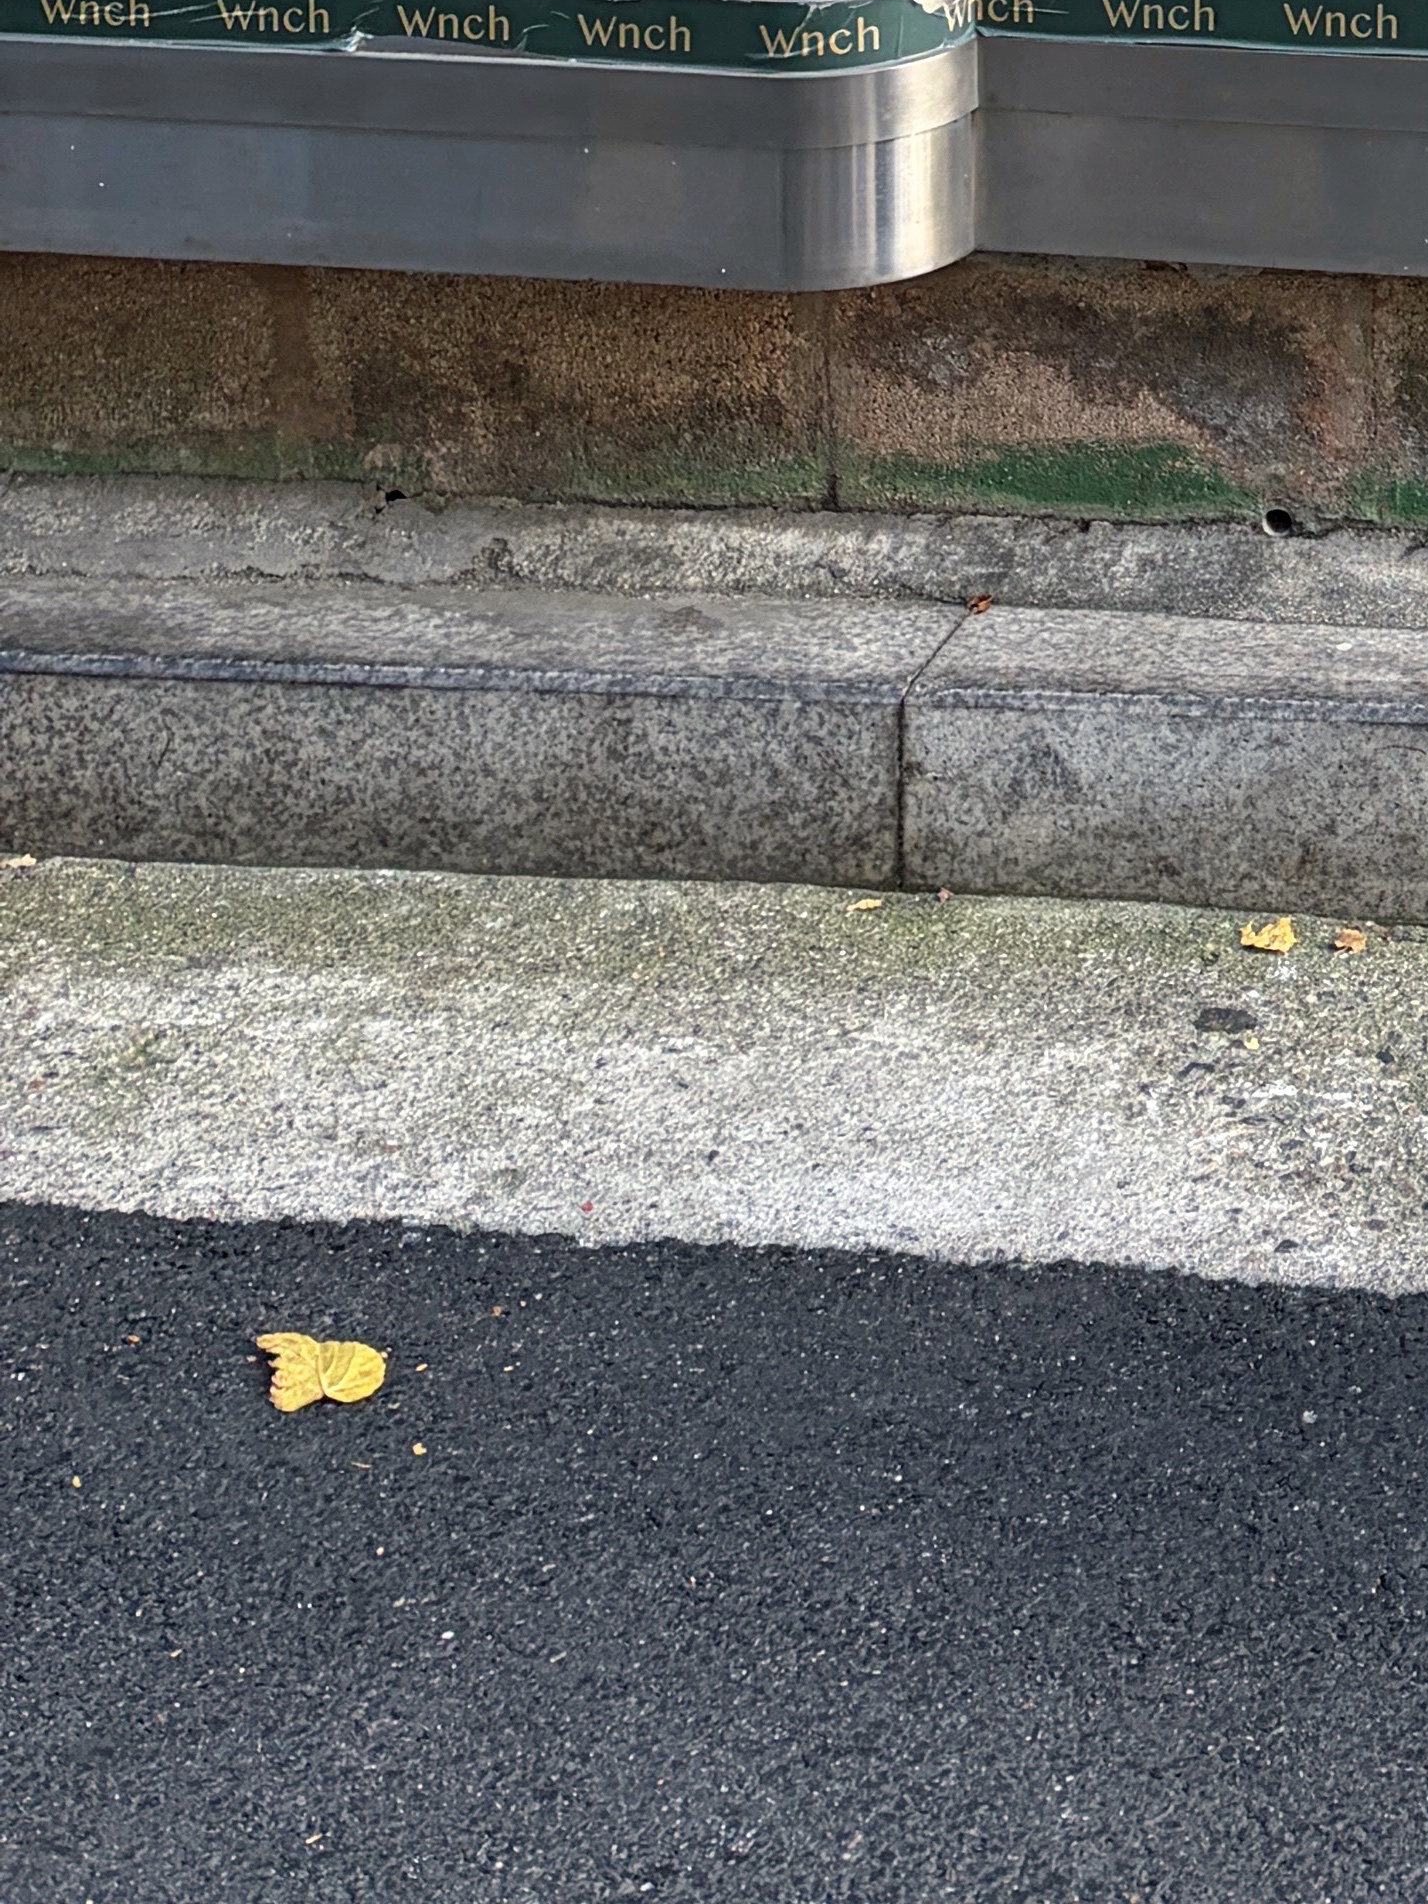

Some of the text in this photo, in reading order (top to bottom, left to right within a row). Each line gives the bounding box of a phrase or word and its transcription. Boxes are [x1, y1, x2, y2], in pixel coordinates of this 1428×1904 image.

[397, 4, 511, 41] Wnch
[578, 11, 692, 53] Wnch
[760, 17, 882, 58] Wnch
[1283, 2, 1399, 42] Wnch
